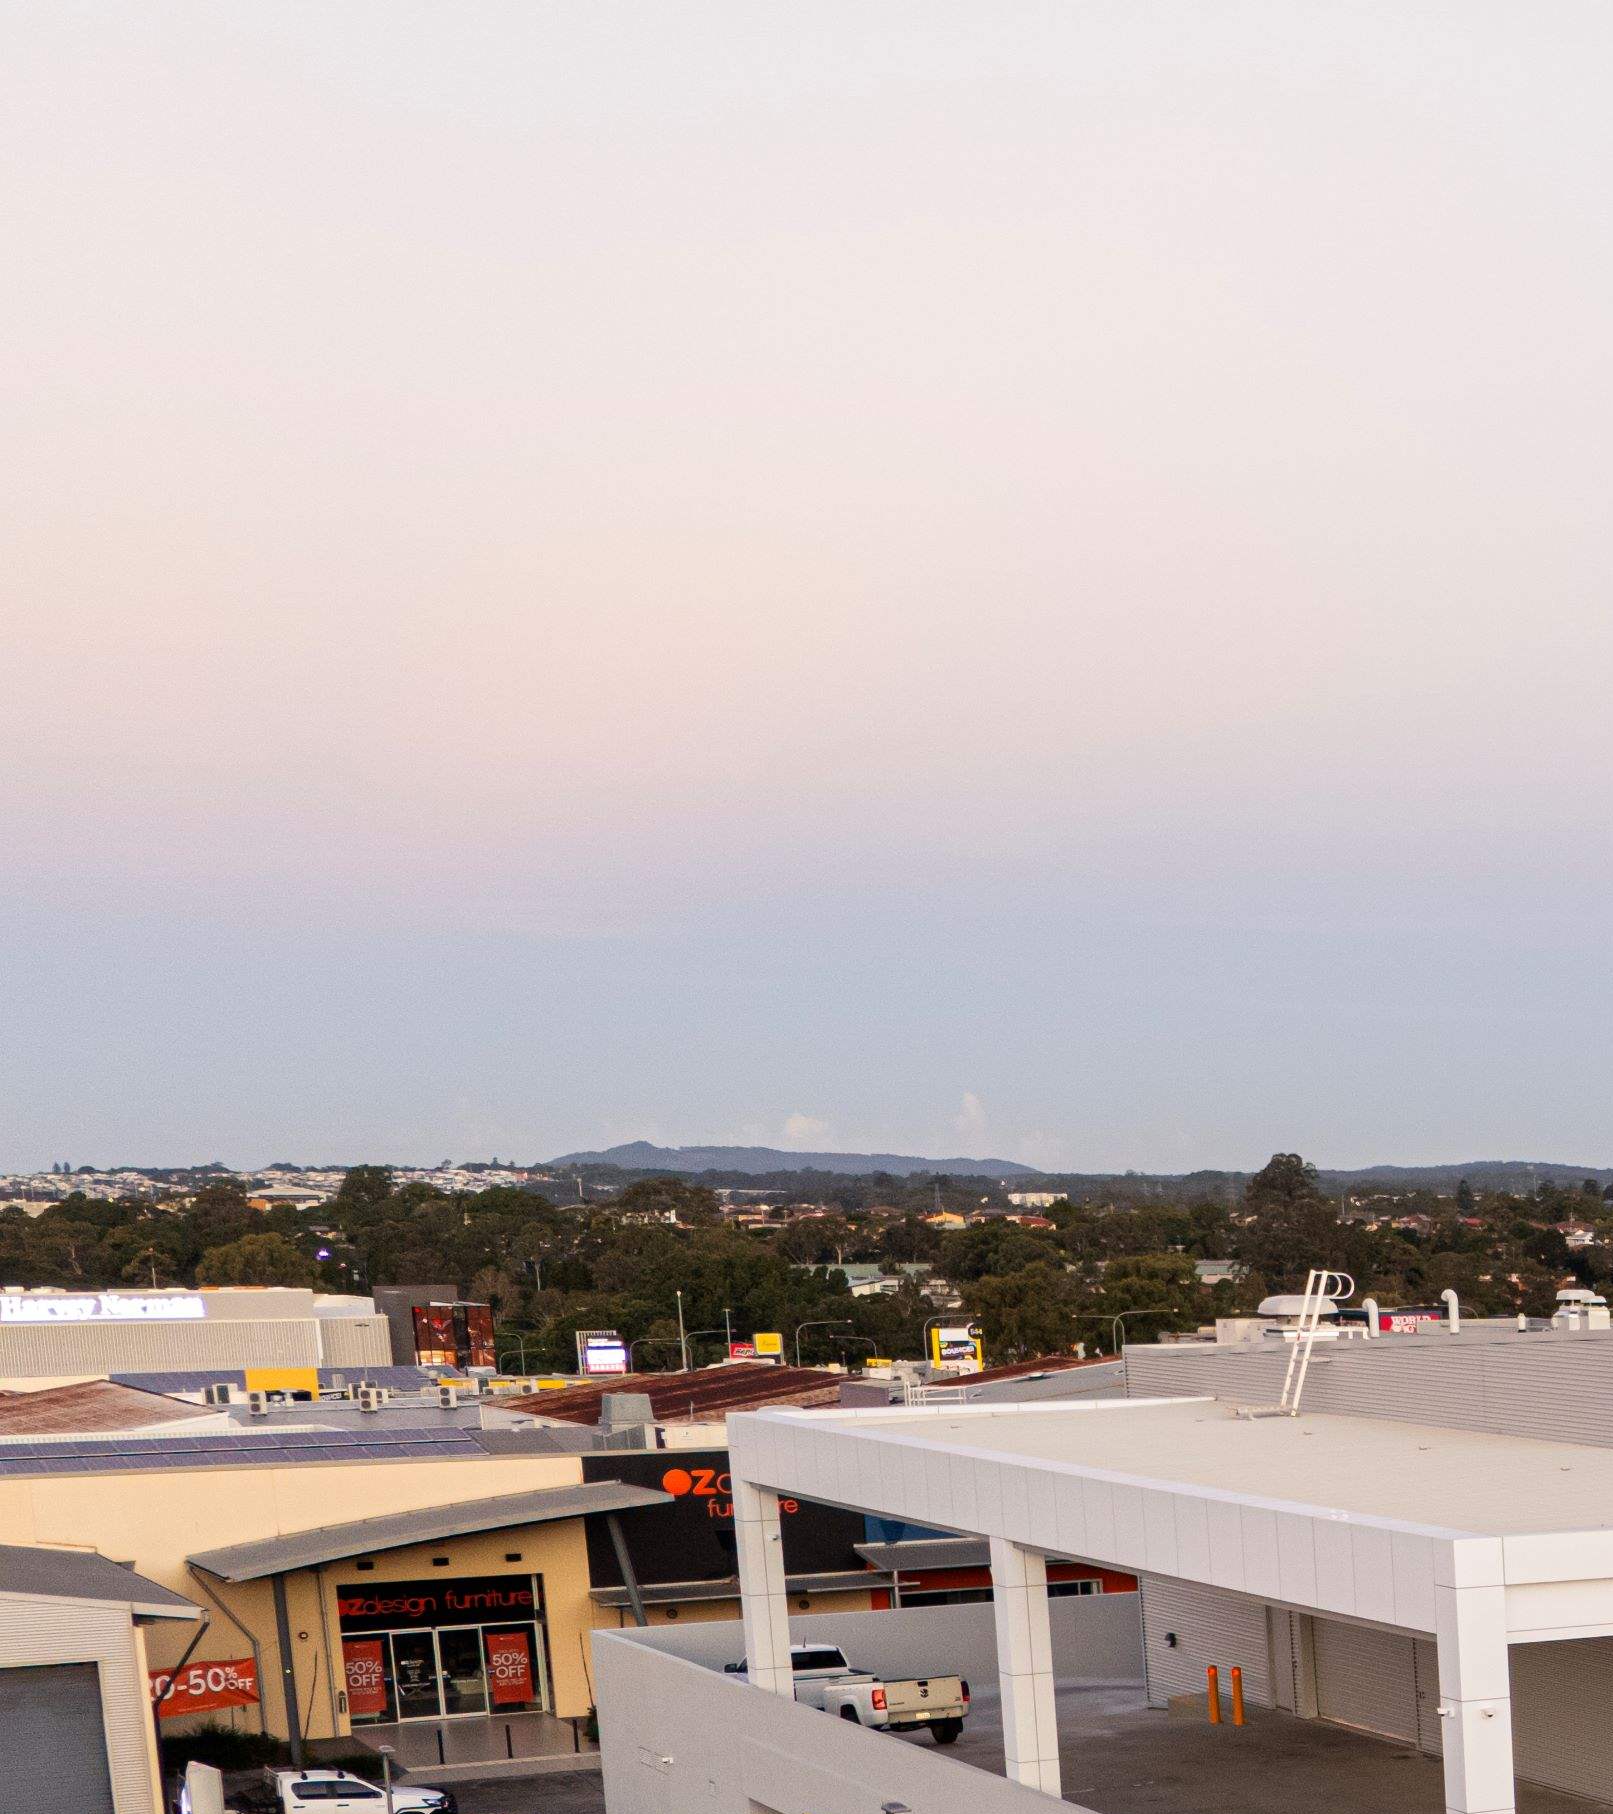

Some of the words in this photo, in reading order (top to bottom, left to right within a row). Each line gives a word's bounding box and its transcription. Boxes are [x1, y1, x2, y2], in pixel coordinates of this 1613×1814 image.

[493, 1652, 528, 1666] 50%
[345, 1660, 383, 1675] 50%
[496, 1664, 526, 1679] OFF
[350, 1673, 380, 1687] OFF
